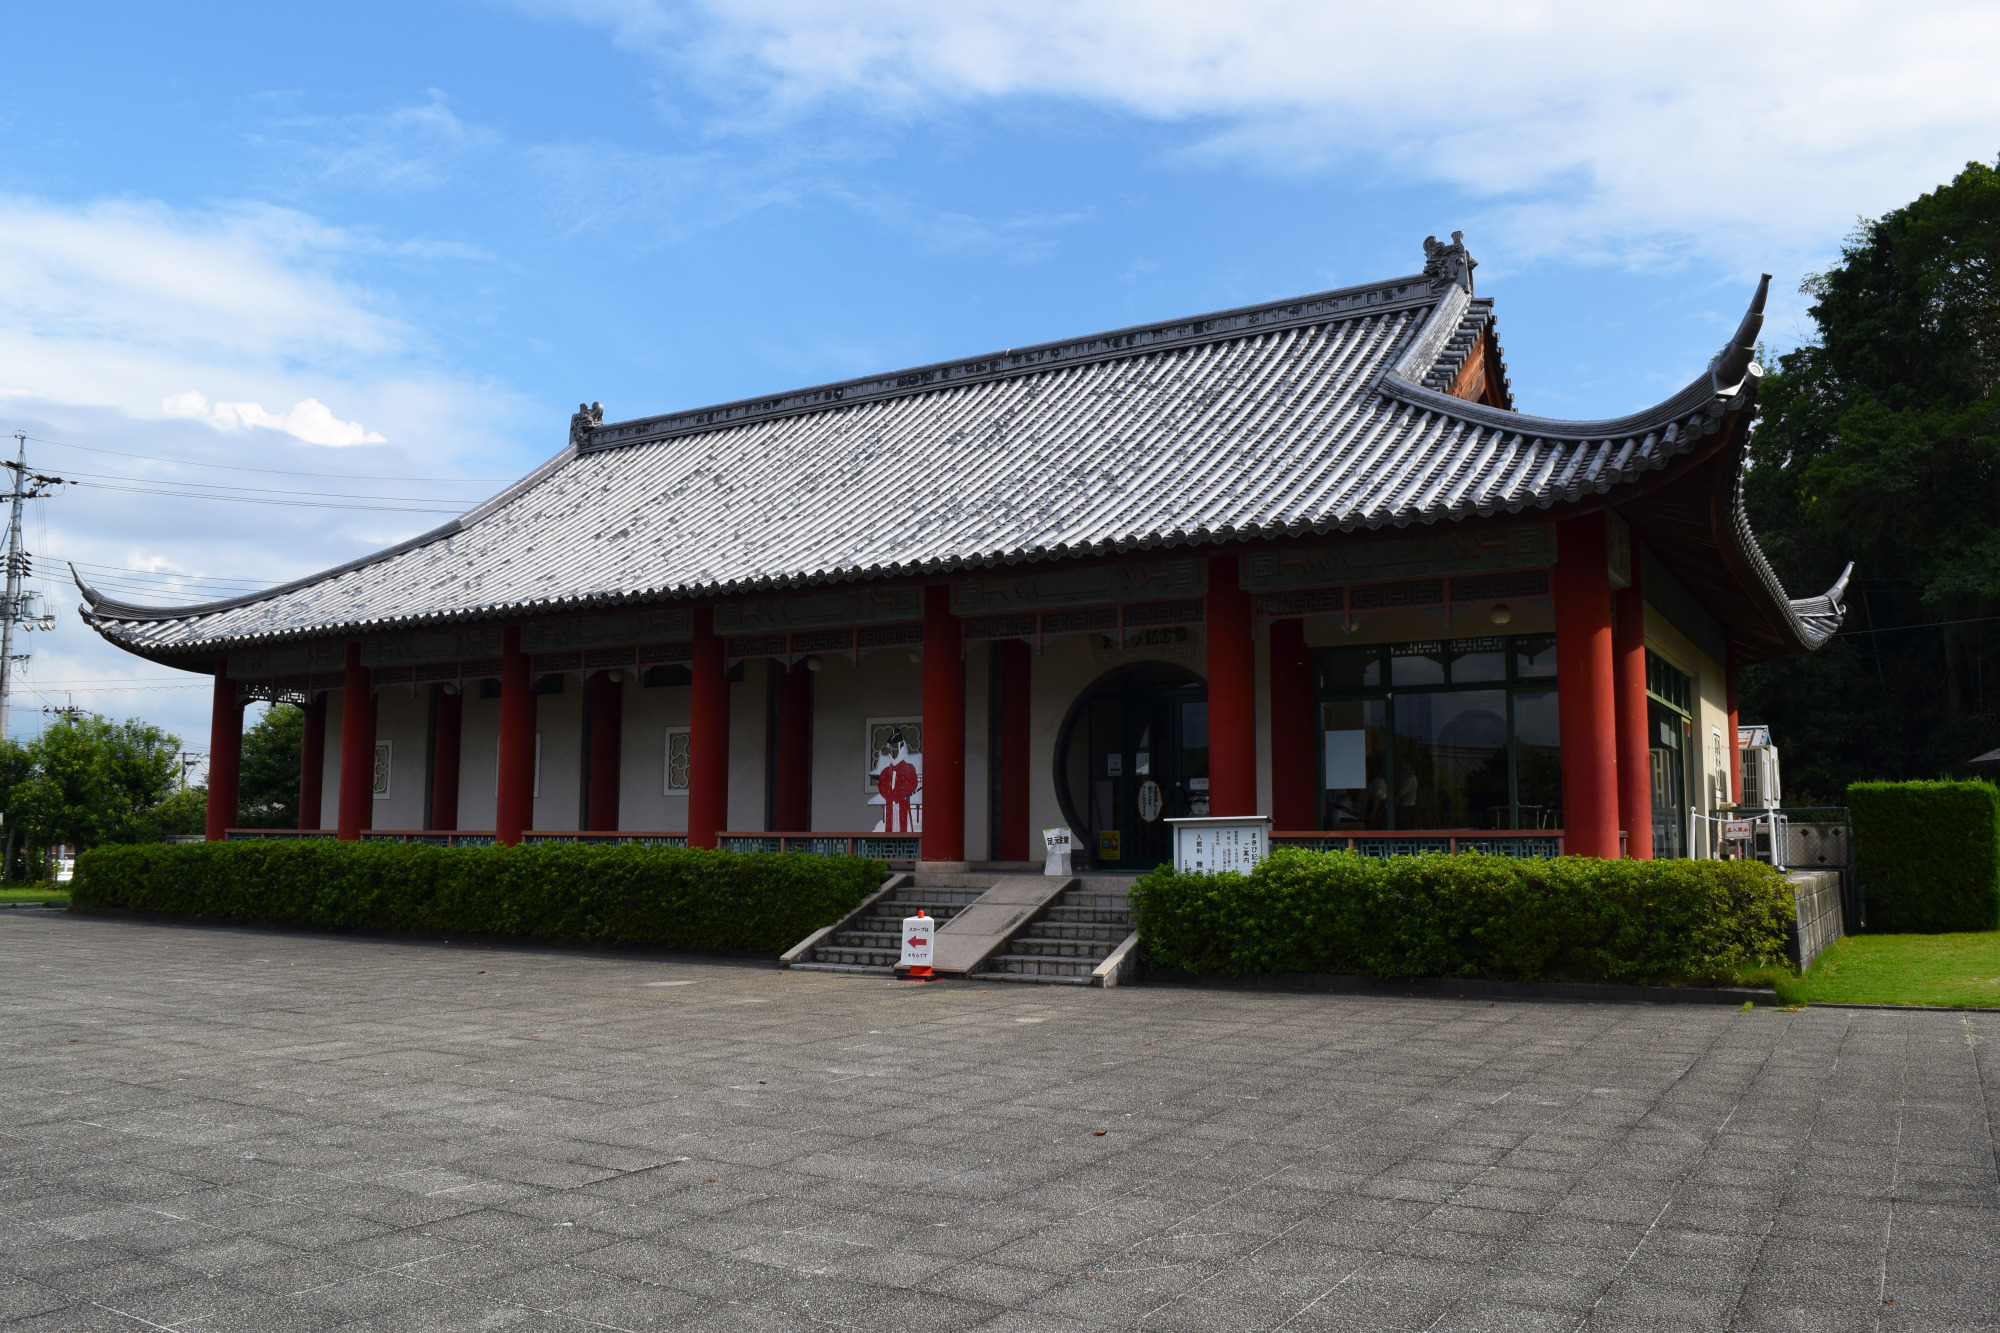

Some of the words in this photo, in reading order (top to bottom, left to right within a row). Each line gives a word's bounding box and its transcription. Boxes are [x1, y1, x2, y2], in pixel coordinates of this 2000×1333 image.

[1102, 625, 1188, 650] まび記念館
[1047, 835, 1069, 845] 足元注意
